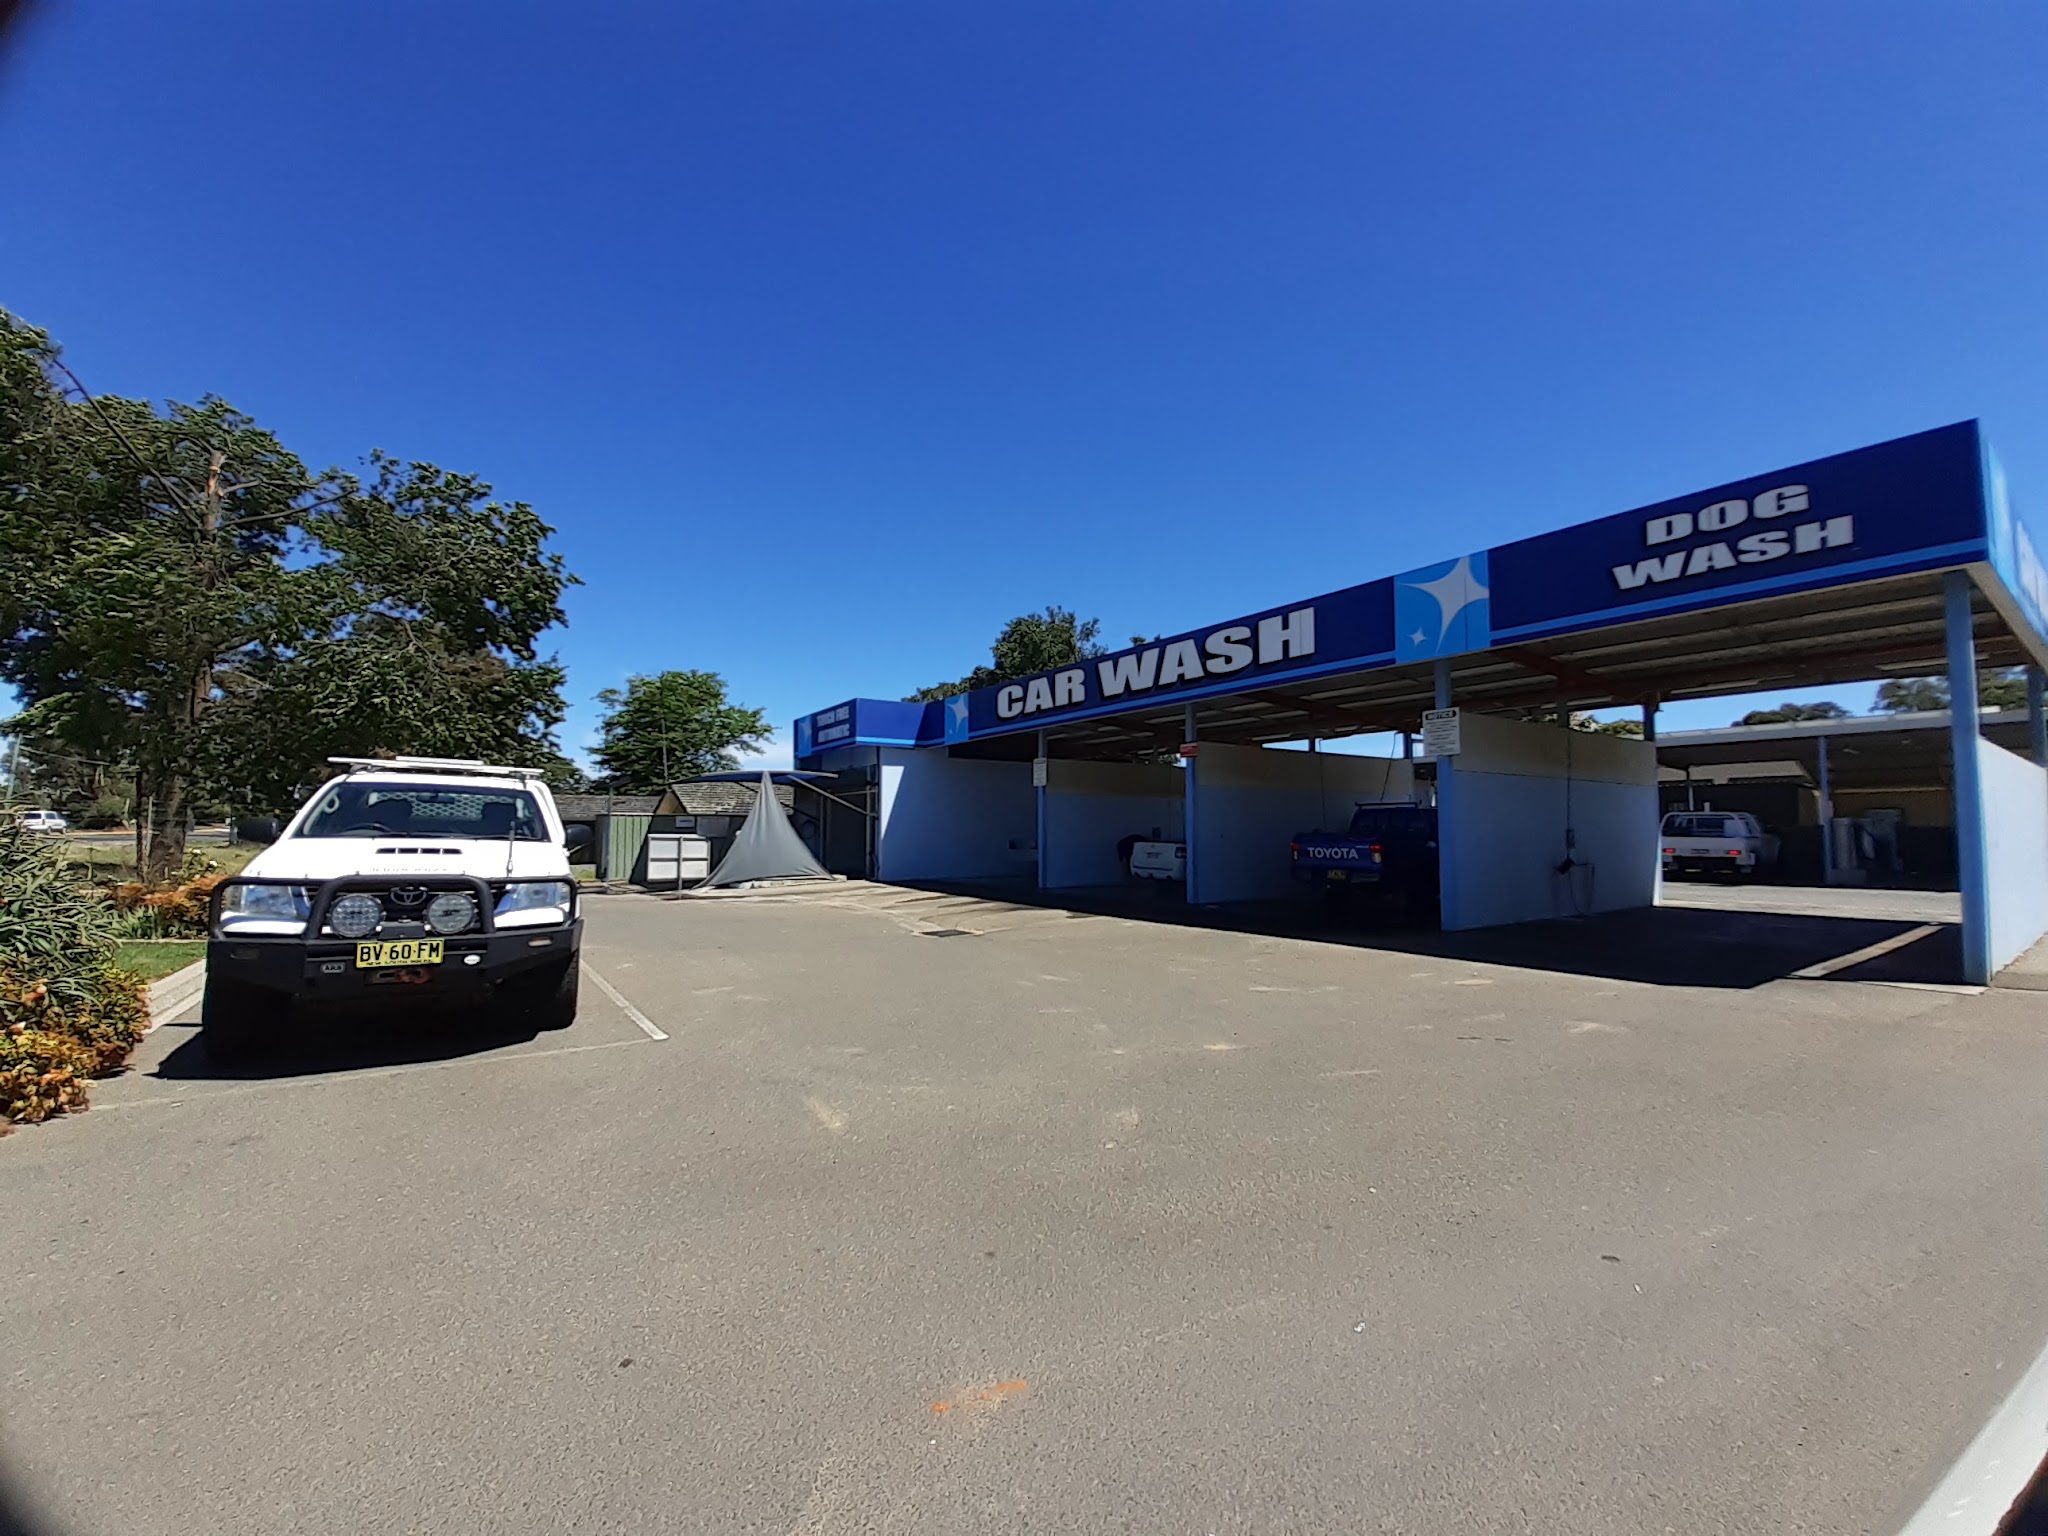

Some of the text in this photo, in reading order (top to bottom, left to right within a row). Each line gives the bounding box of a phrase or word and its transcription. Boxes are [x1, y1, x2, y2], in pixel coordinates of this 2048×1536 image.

[1646, 484, 1809, 546] DOG
[1612, 515, 1854, 590] WASH
[997, 607, 1316, 719] CAR WASH
[1307, 847, 1359, 860] TOYOTA
